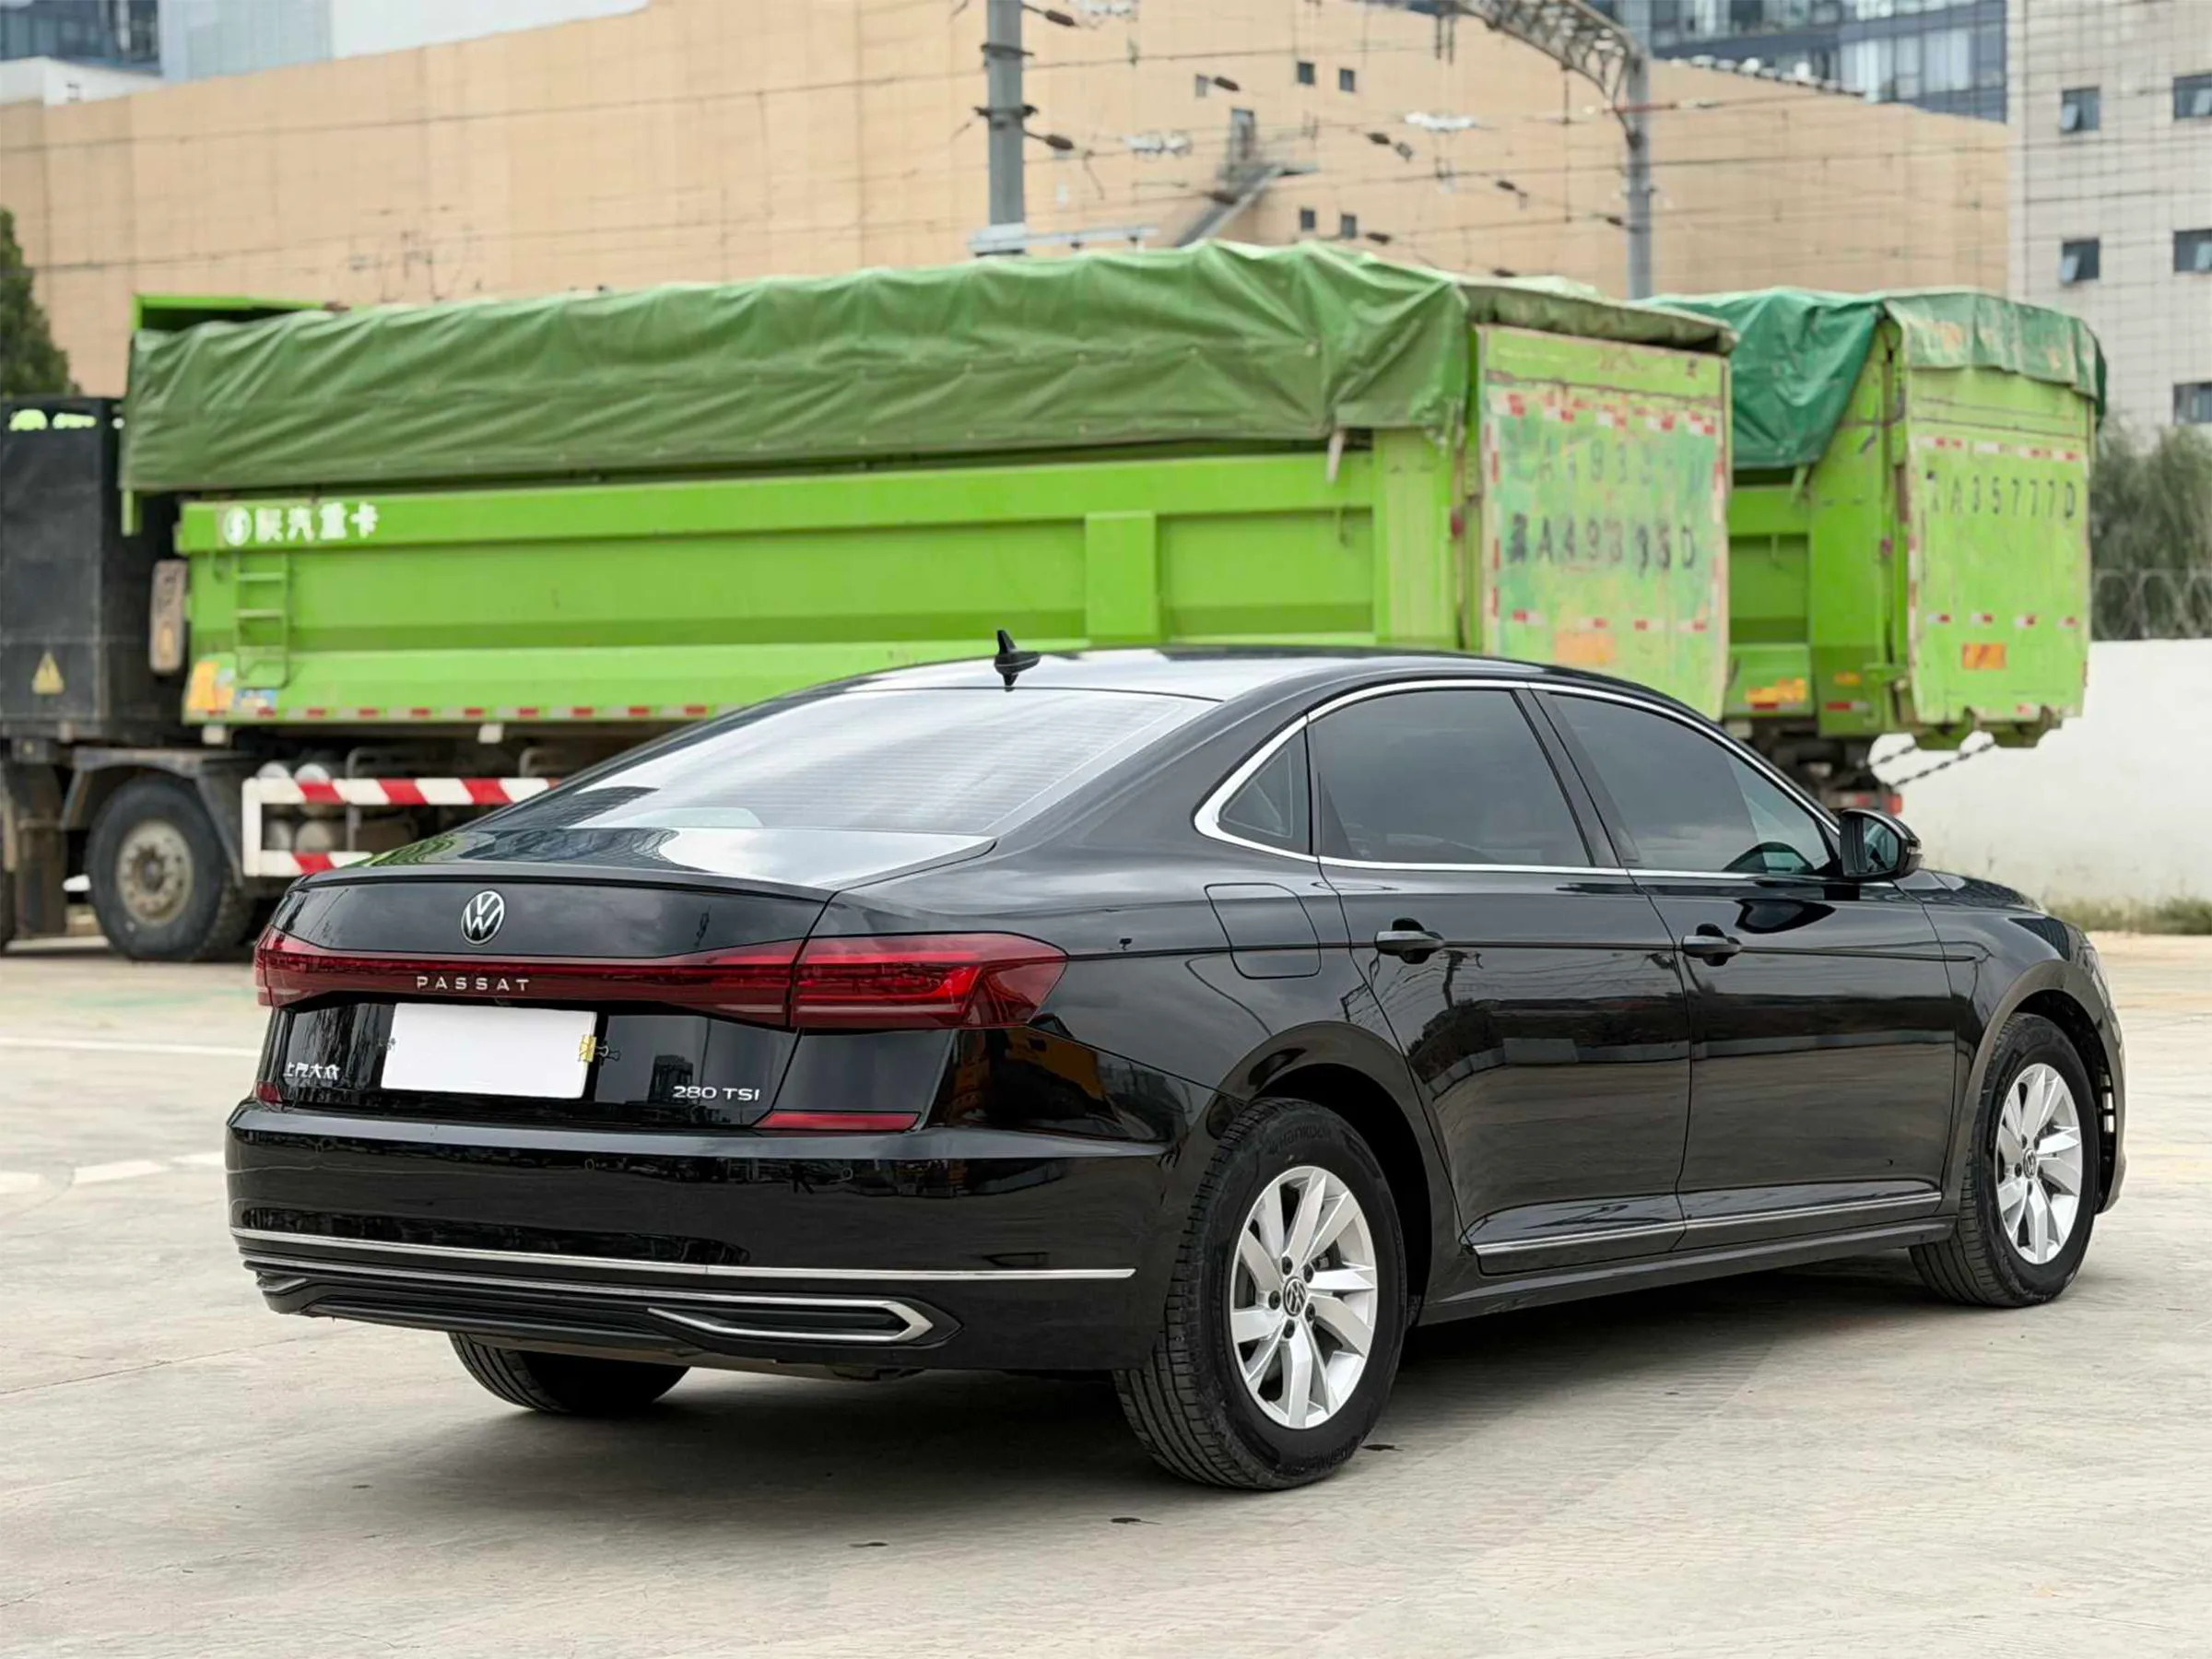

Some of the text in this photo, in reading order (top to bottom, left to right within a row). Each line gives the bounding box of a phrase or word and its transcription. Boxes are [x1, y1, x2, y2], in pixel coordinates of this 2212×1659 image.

[417, 976, 530, 992] PASSAT
[672, 1086, 760, 1101] 280 TSI
